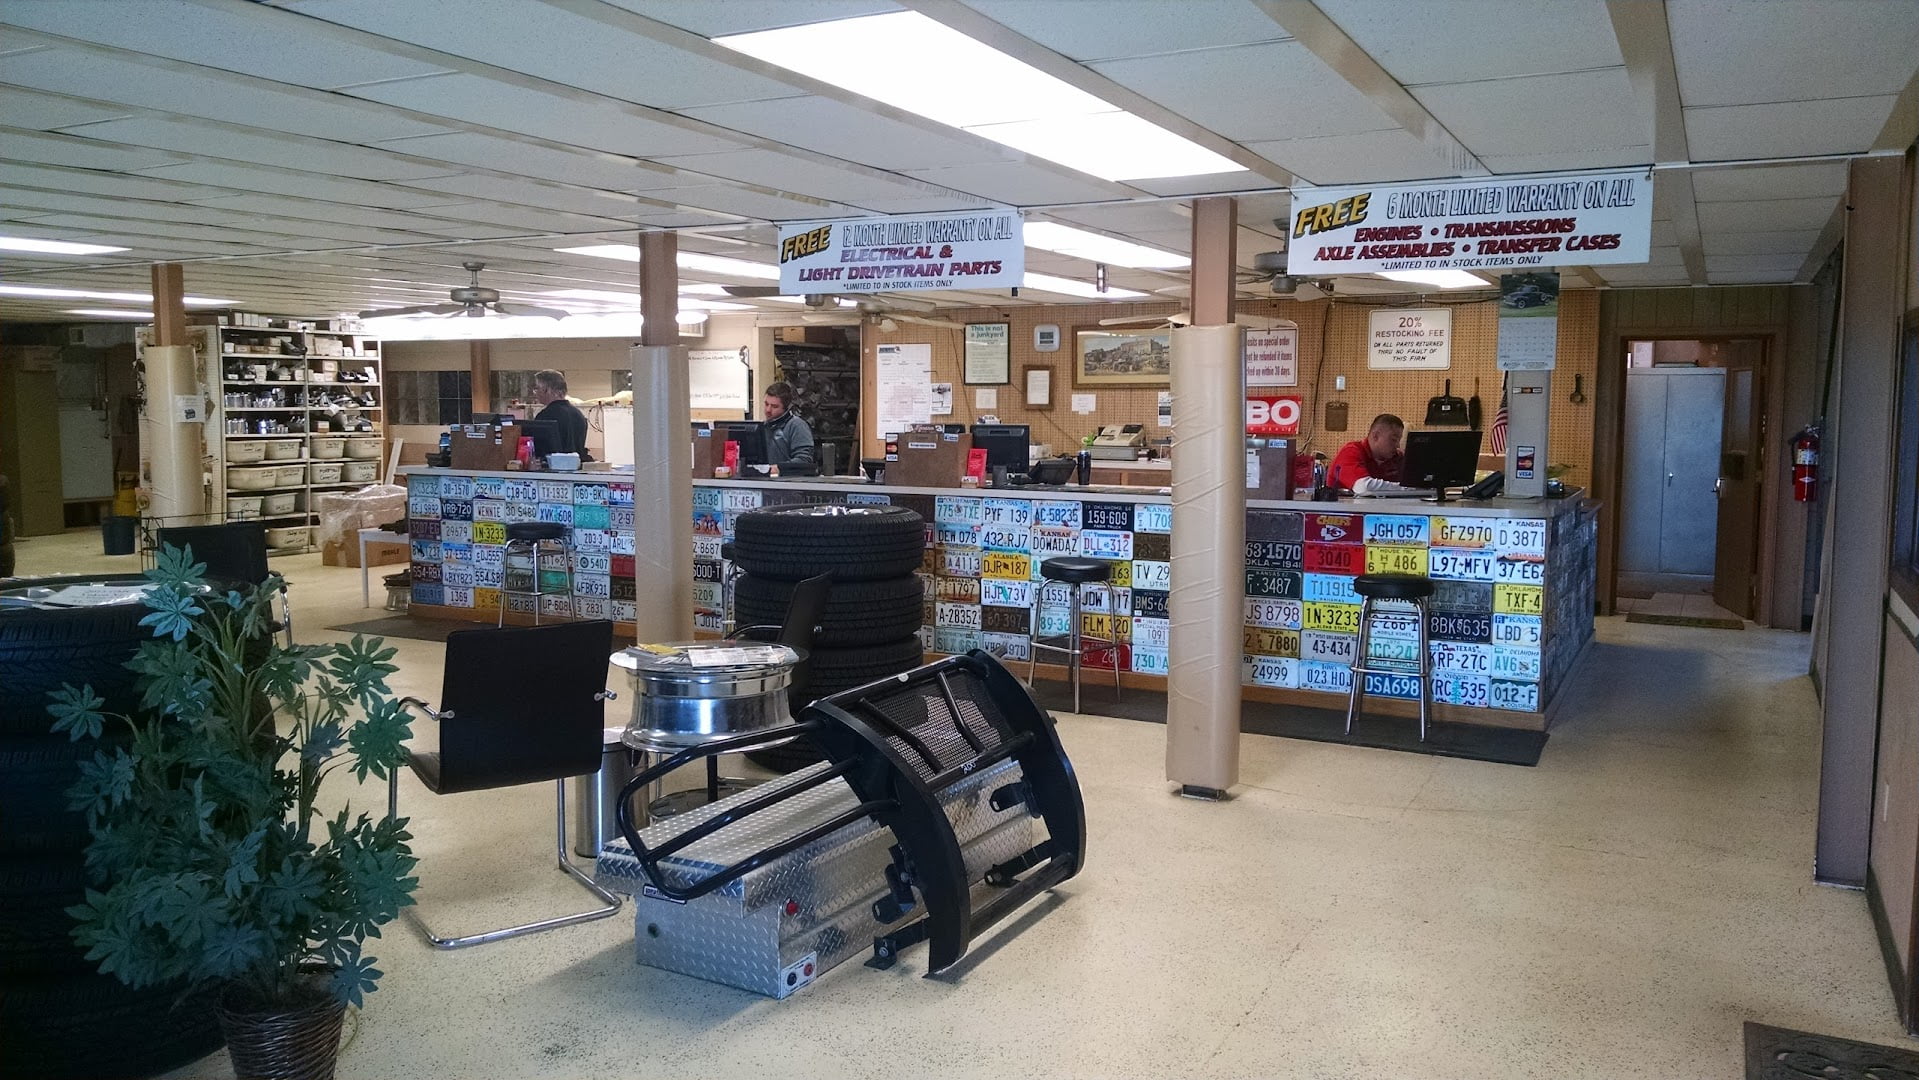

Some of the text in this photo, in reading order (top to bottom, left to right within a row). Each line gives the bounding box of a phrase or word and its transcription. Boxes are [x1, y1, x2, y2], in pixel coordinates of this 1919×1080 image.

[1387, 178, 1635, 219] 6 MONTH LIMITED WARRANTY ON ALL
[1292, 192, 1372, 239] FREE
[843, 215, 1012, 247] 12 MONTH LIMITED WARRANTY ON ALL
[1354, 217, 1577, 242] ENGINES TRANSMISSIONS
[781, 224, 832, 263] FREE
[1314, 233, 1621, 262] AXLE ASSEMBLIES TRANSFER CASES
[840, 245, 953, 263] ELECTRICAL &
[1425, 260, 1436, 268] TO
[1439, 259, 1450, 268] IN
[1453, 258, 1482, 267] STOCK
[1486, 256, 1514, 266] ITEMS
[1518, 255, 1543, 265] ONLY
[799, 260, 1002, 282] LIGHT DRIVETRAIN PARTS
[873, 282, 881, 290] TO
[882, 281, 890, 289] IN
[891, 280, 913, 289] STOCK
[935, 279, 953, 288] ONLY
[1399, 316, 1422, 328] 20%
[1375, 329, 1445, 338] RESTOCKING FEE
[1246, 399, 1300, 426] BO
[937, 504, 980, 520] 775 TXE
[984, 507, 1028, 524] PYF 139
[1316, 515, 1352, 526] CHIEFS
[959, 531, 977, 544] 078
[984, 531, 1028, 548] 432 RJ7
[1370, 523, 1422, 539] JGH 057
[1441, 525, 1492, 542] GFZ970
[1084, 537, 1102, 550] DLL
[1110, 538, 1129, 552] 312
[1318, 550, 1351, 568] 3040
[1394, 555, 1417, 571] 486
[1432, 556, 1490, 575] L97 MFV
[984, 560, 1027, 576] DJR 187
[1136, 565, 1150, 580] TV
[984, 585, 1026, 601] HJP 73V
[1082, 591, 1103, 607] JDW
[1246, 604, 1300, 622] JS 8798
[1083, 616, 1104, 633] FLM
[1431, 616, 1489, 637] 8BK 635
[1496, 624, 1521, 641] LBD
[1009, 645, 1026, 657] 97D
[1268, 635, 1298, 652] 7880
[1430, 652, 1487, 671] KRP 27C
[1495, 655, 1517, 671] AV6
[1252, 664, 1288, 681] 24999
[1307, 669, 1327, 684] 023
[1365, 675, 1419, 696] DSA698
[1460, 682, 1486, 700] 535
